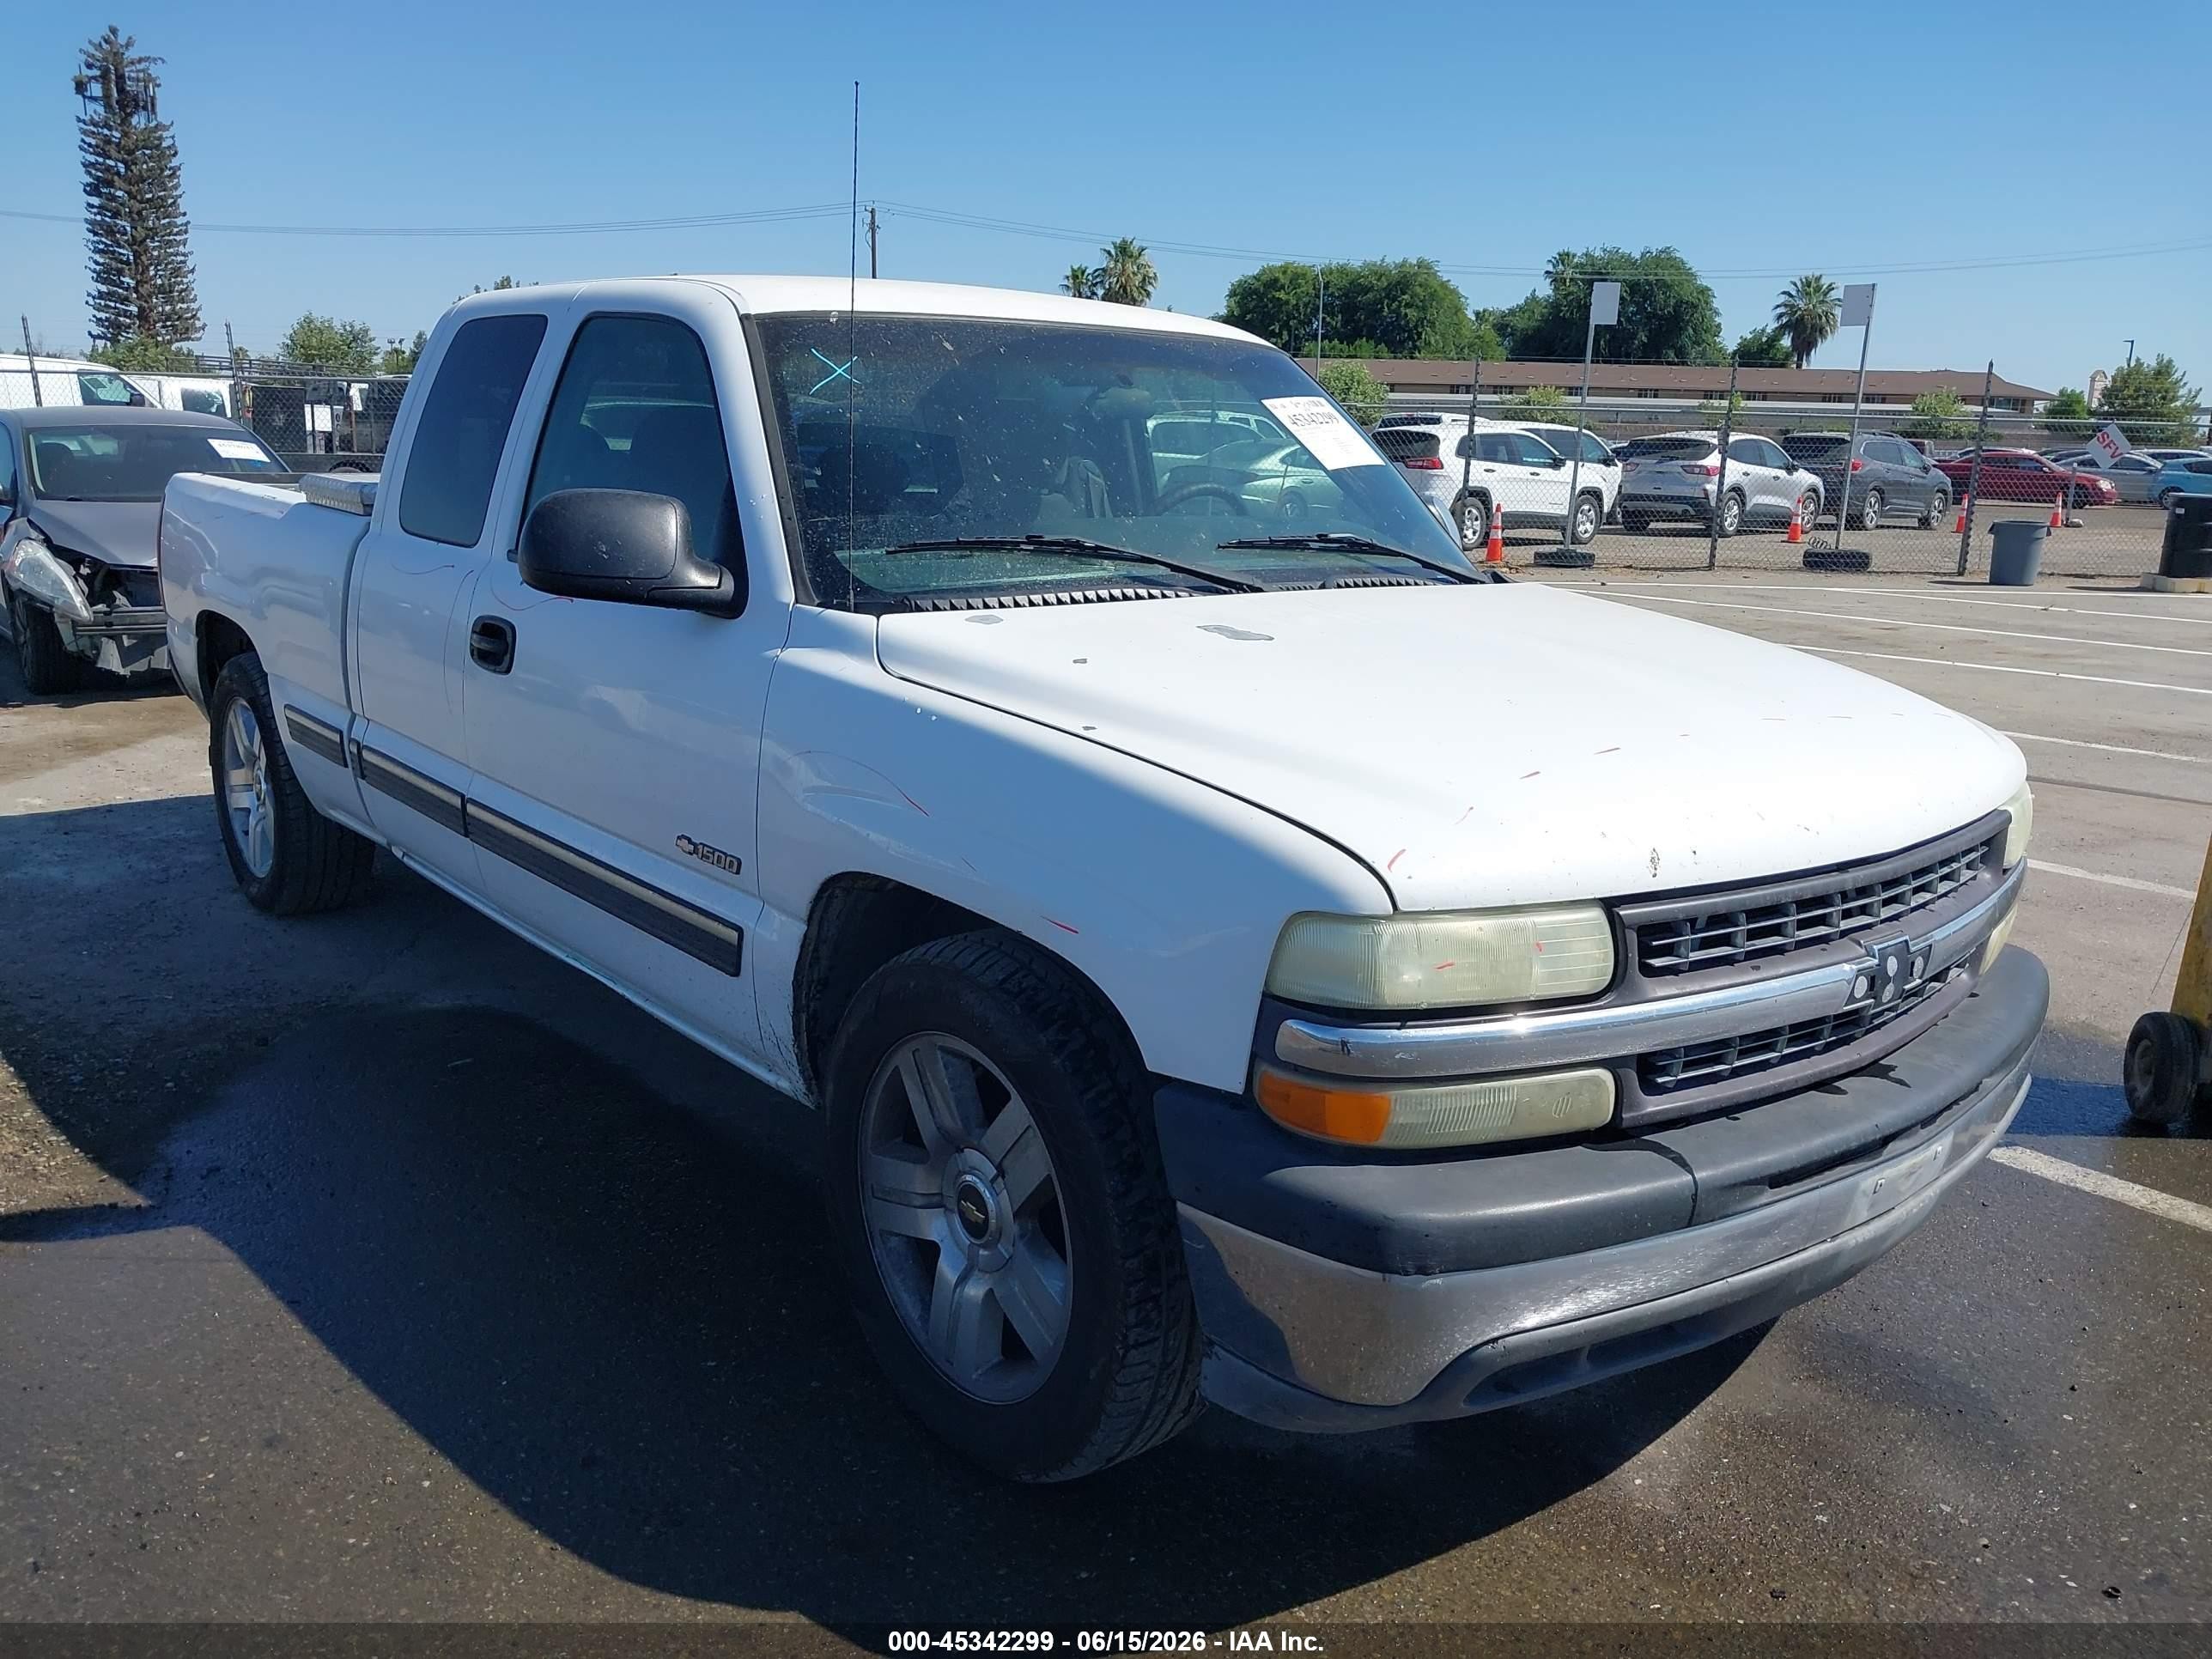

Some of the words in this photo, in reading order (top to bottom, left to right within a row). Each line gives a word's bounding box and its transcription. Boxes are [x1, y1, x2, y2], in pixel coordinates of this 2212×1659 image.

[1288, 412, 1340, 427] 45342299
[2096, 431, 2124, 459] SFV
[697, 843, 739, 874] 1500
